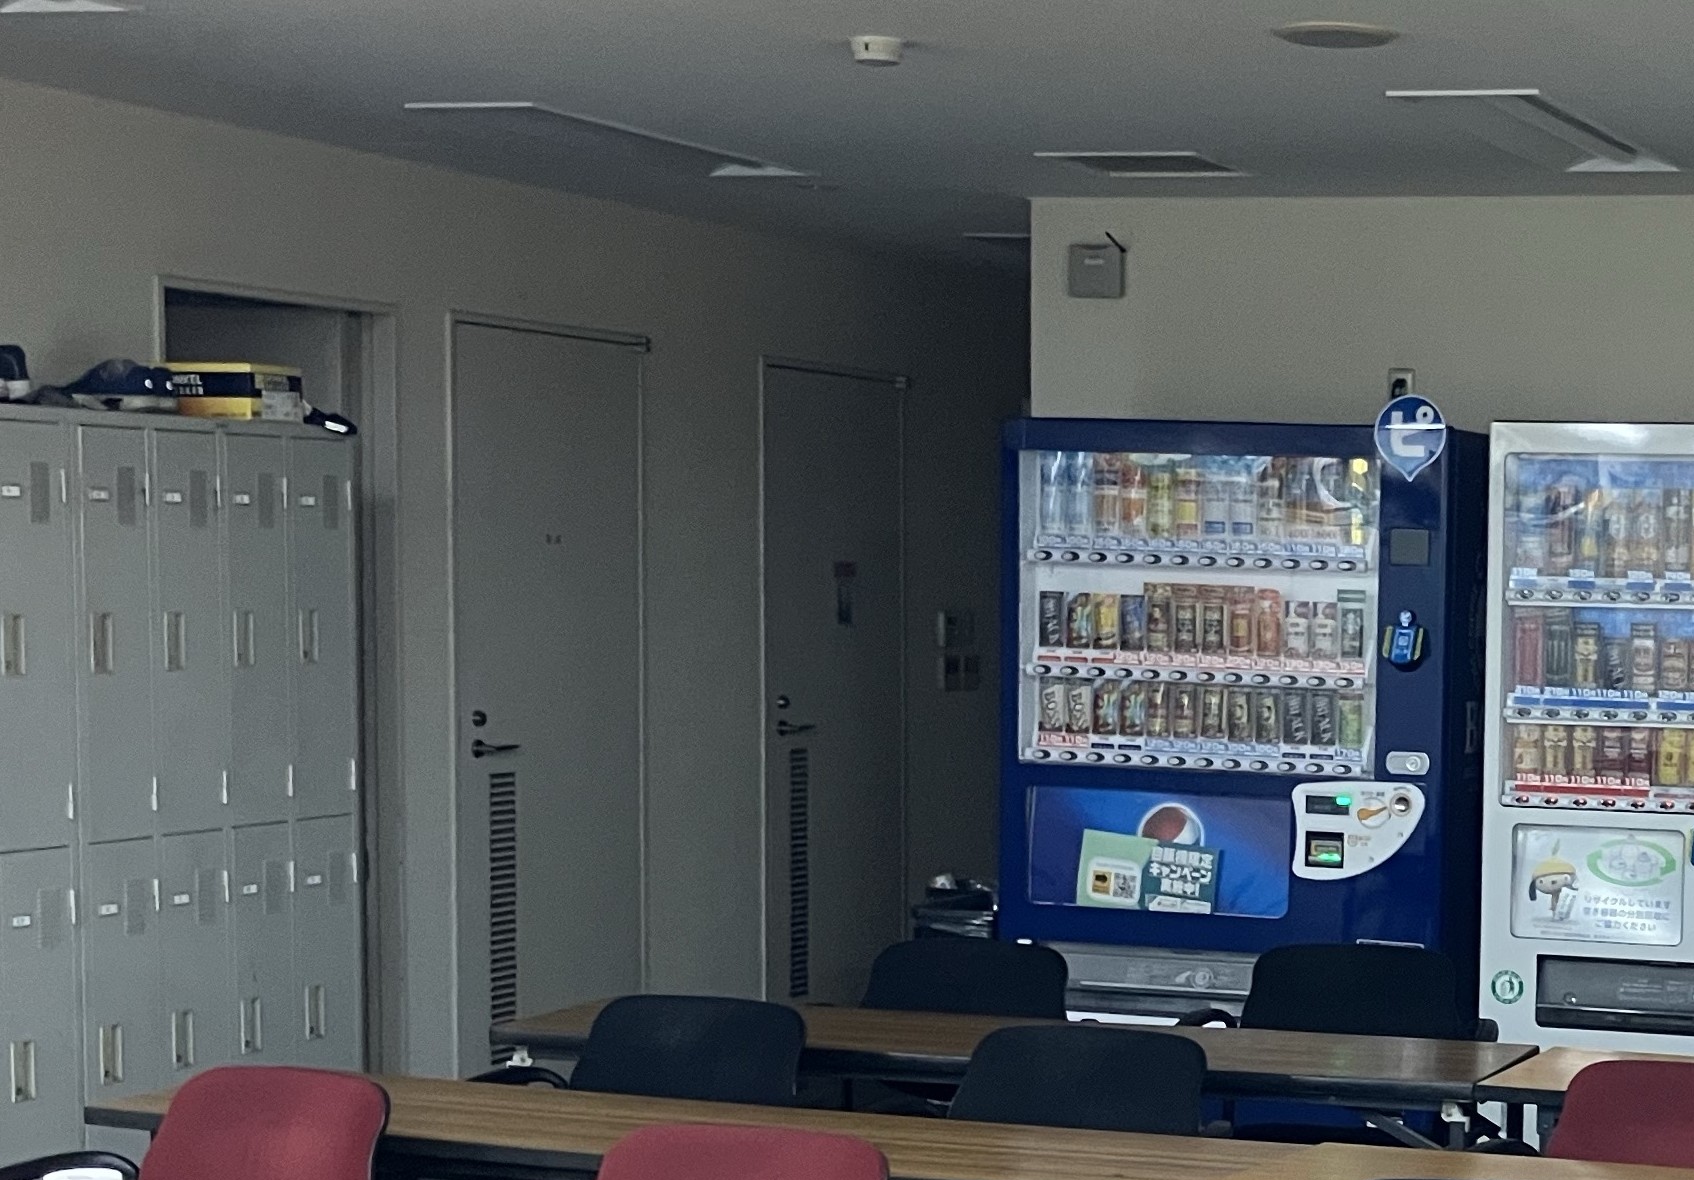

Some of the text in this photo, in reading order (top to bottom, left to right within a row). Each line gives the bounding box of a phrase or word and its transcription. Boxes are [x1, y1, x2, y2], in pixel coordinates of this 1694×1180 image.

[1149, 862, 1212, 883] キャンペーン
